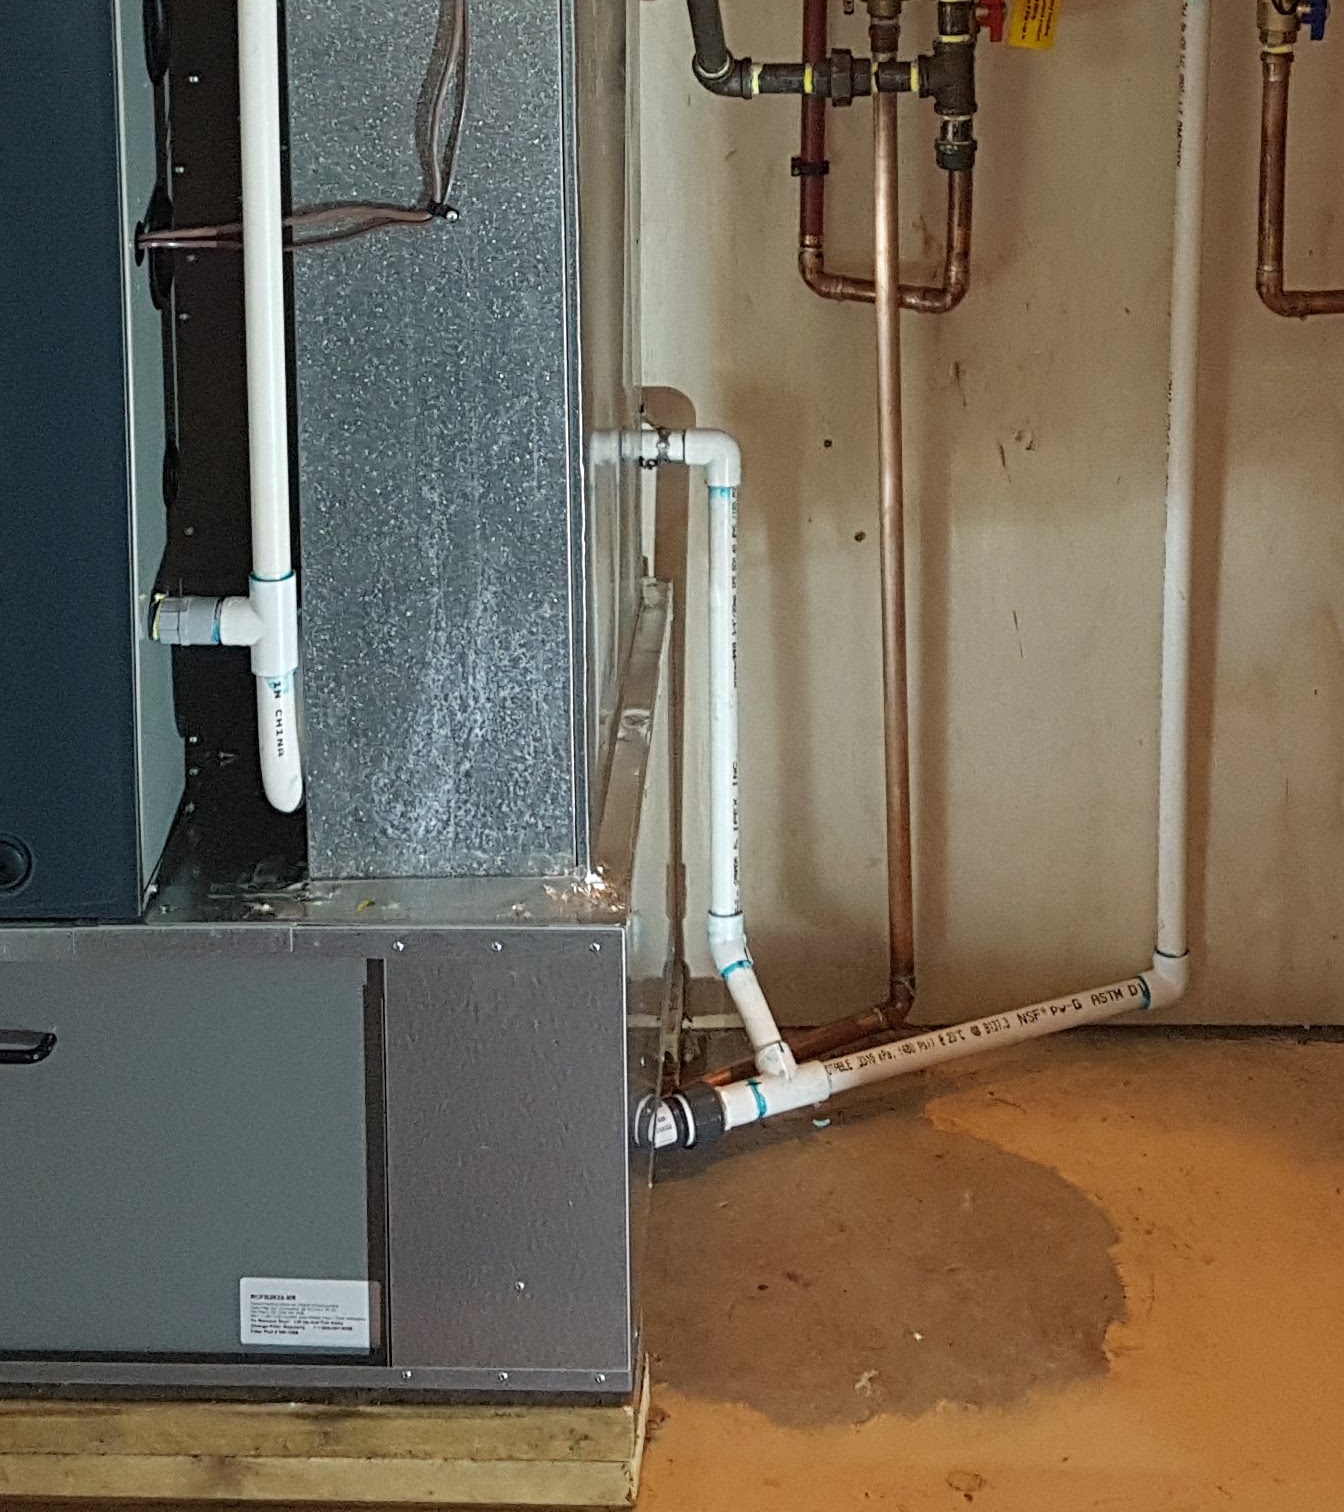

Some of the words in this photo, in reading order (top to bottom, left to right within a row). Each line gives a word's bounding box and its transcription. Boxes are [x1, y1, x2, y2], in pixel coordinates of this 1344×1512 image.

[273, 680, 282, 700] IN
[274, 708, 285, 758] CHINA
[1090, 989, 1125, 1006] ASTM
